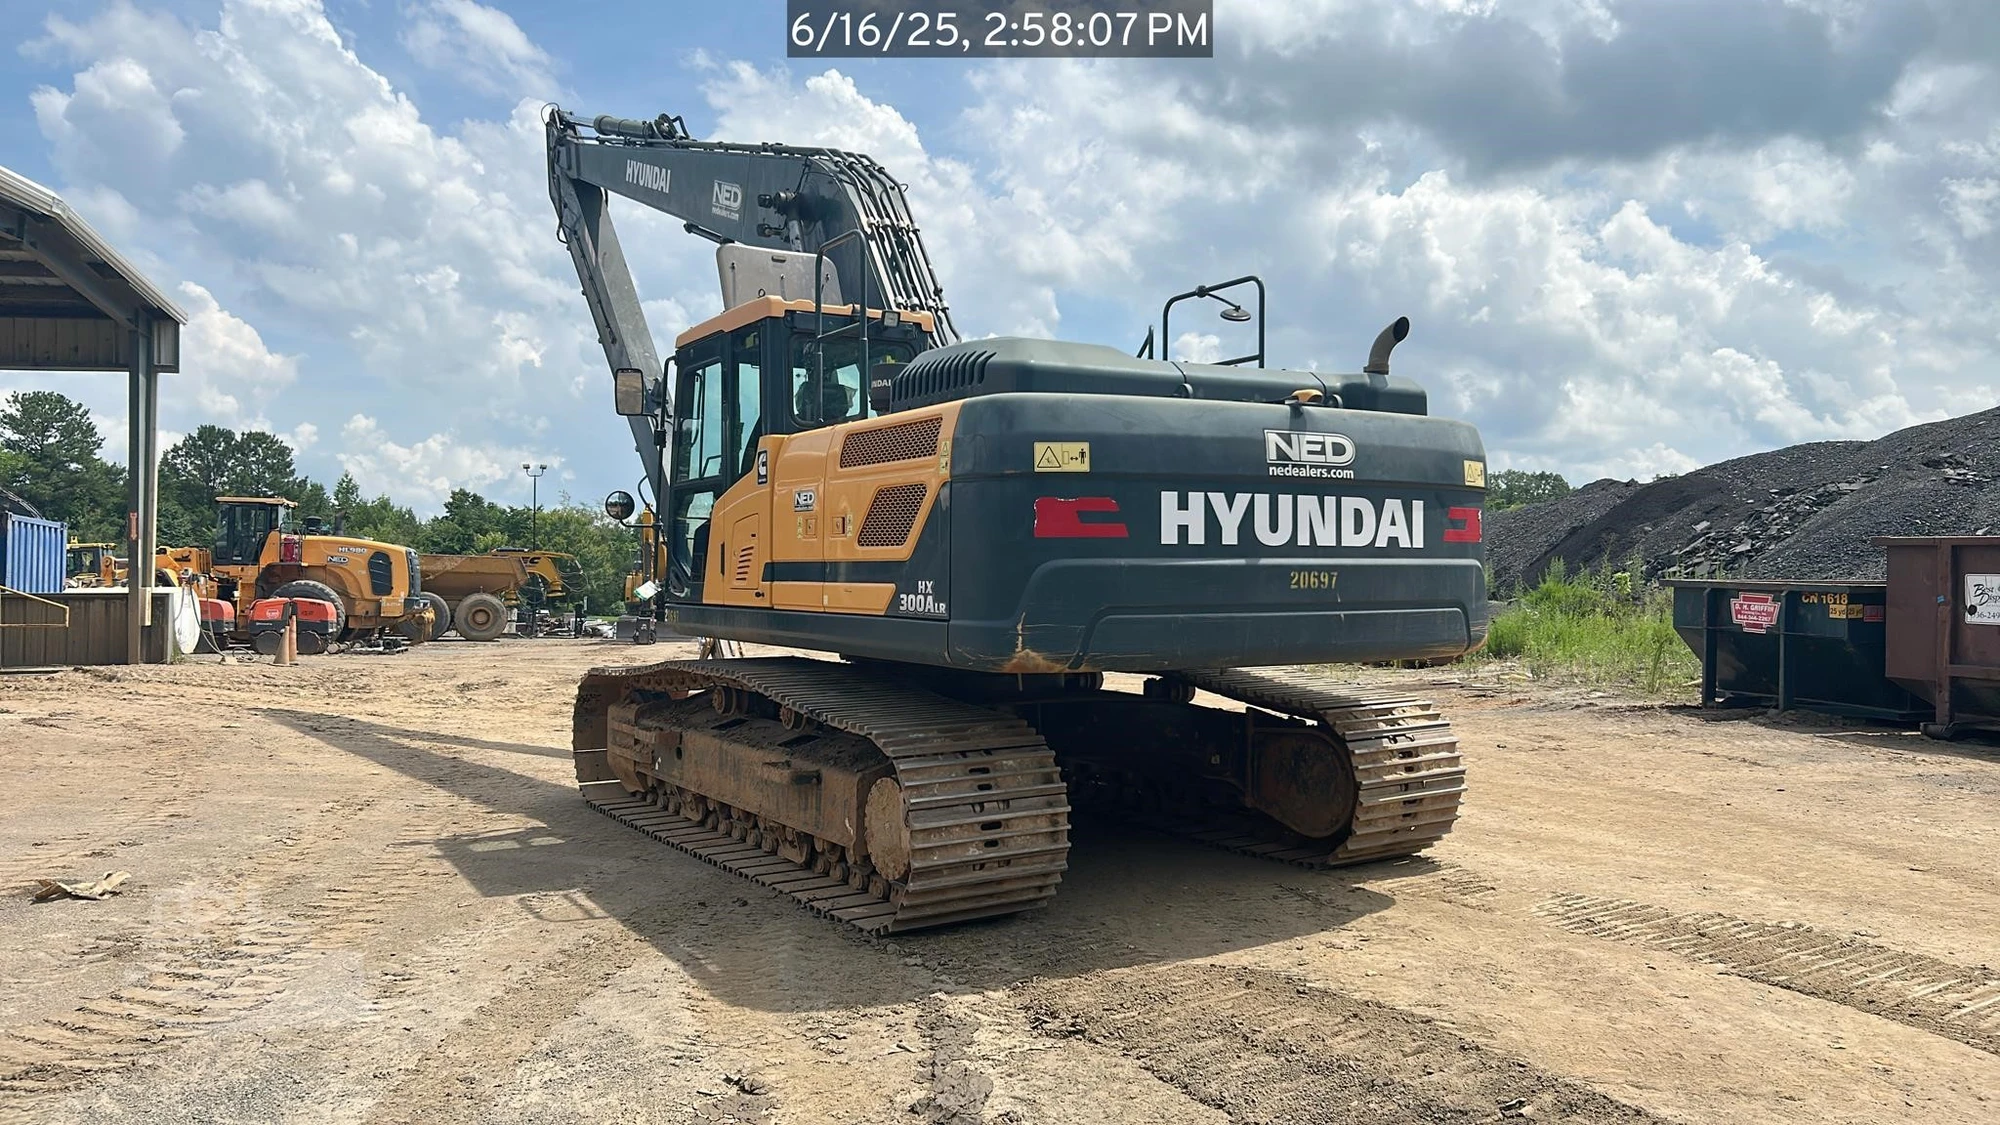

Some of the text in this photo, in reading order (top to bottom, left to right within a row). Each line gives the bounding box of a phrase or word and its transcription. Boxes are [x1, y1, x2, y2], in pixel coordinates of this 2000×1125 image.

[625, 159, 671, 194] HYUNDAI
[712, 180, 743, 211] NED
[1266, 431, 1354, 464] NED
[1268, 464, 1354, 479] nedealers.com
[794, 491, 815, 506] NED
[1160, 491, 1425, 549] HYUNDAI
[917, 580, 934, 594] HX
[1290, 570, 1338, 590] 20697
[1820, 593, 1848, 605] 1618
[1978, 593, 2000, 606] Disp
